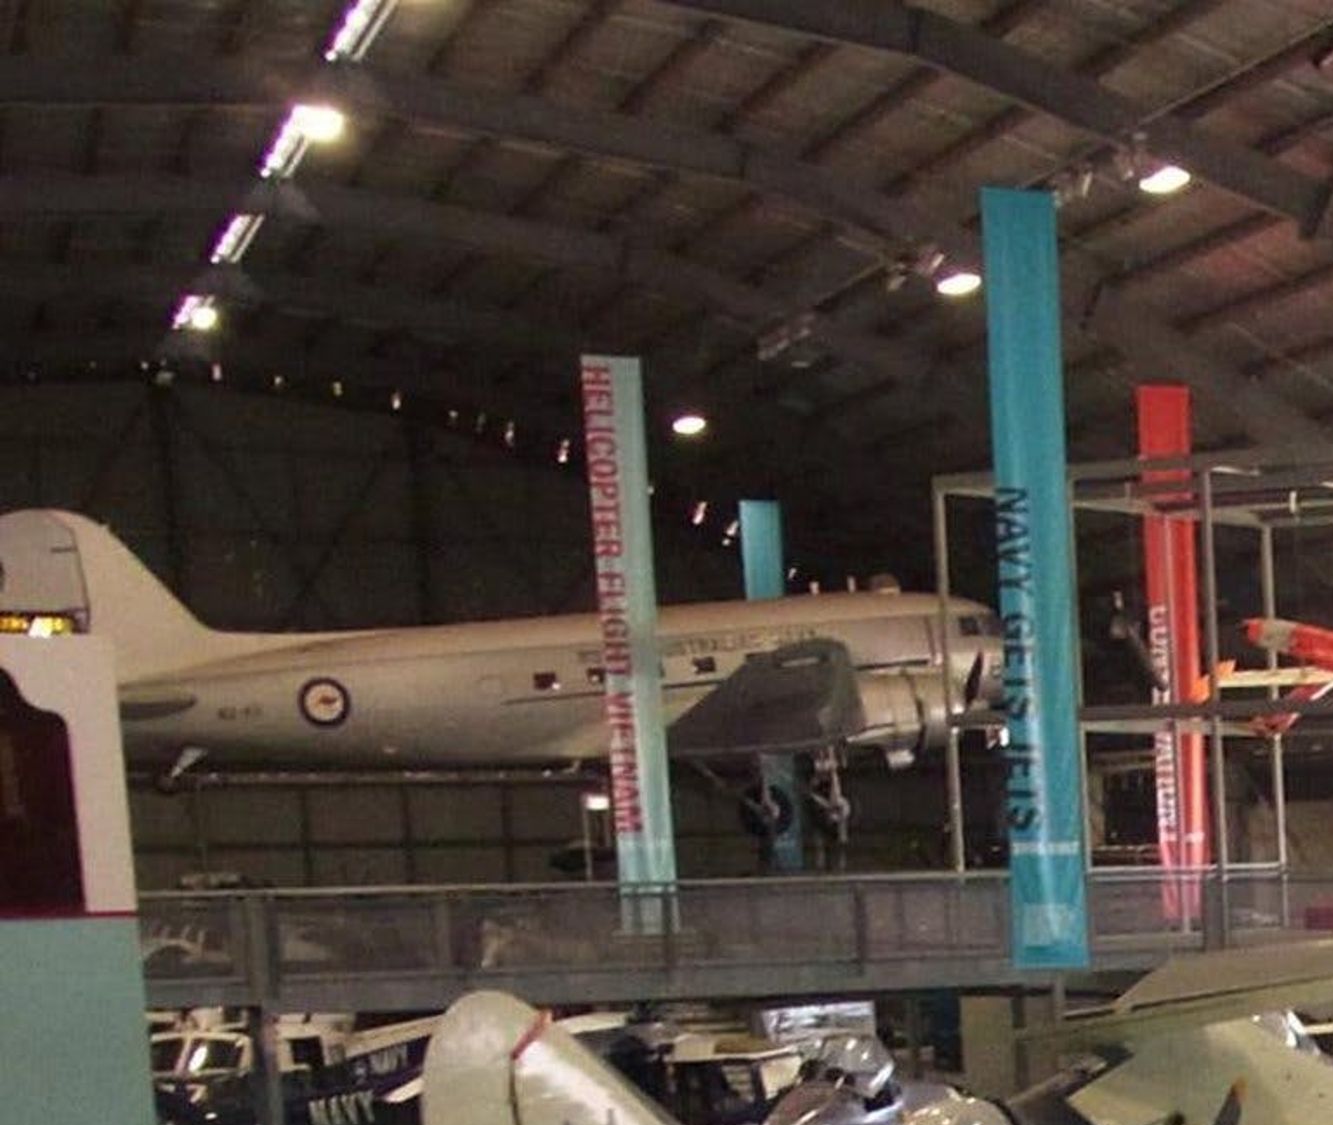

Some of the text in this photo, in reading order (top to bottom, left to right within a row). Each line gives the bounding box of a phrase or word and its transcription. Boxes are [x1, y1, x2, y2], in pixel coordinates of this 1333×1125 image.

[582, 366, 624, 558] HELICOPTER
[996, 488, 1034, 595] NAVY
[597, 570, 631, 677] FLIGHT
